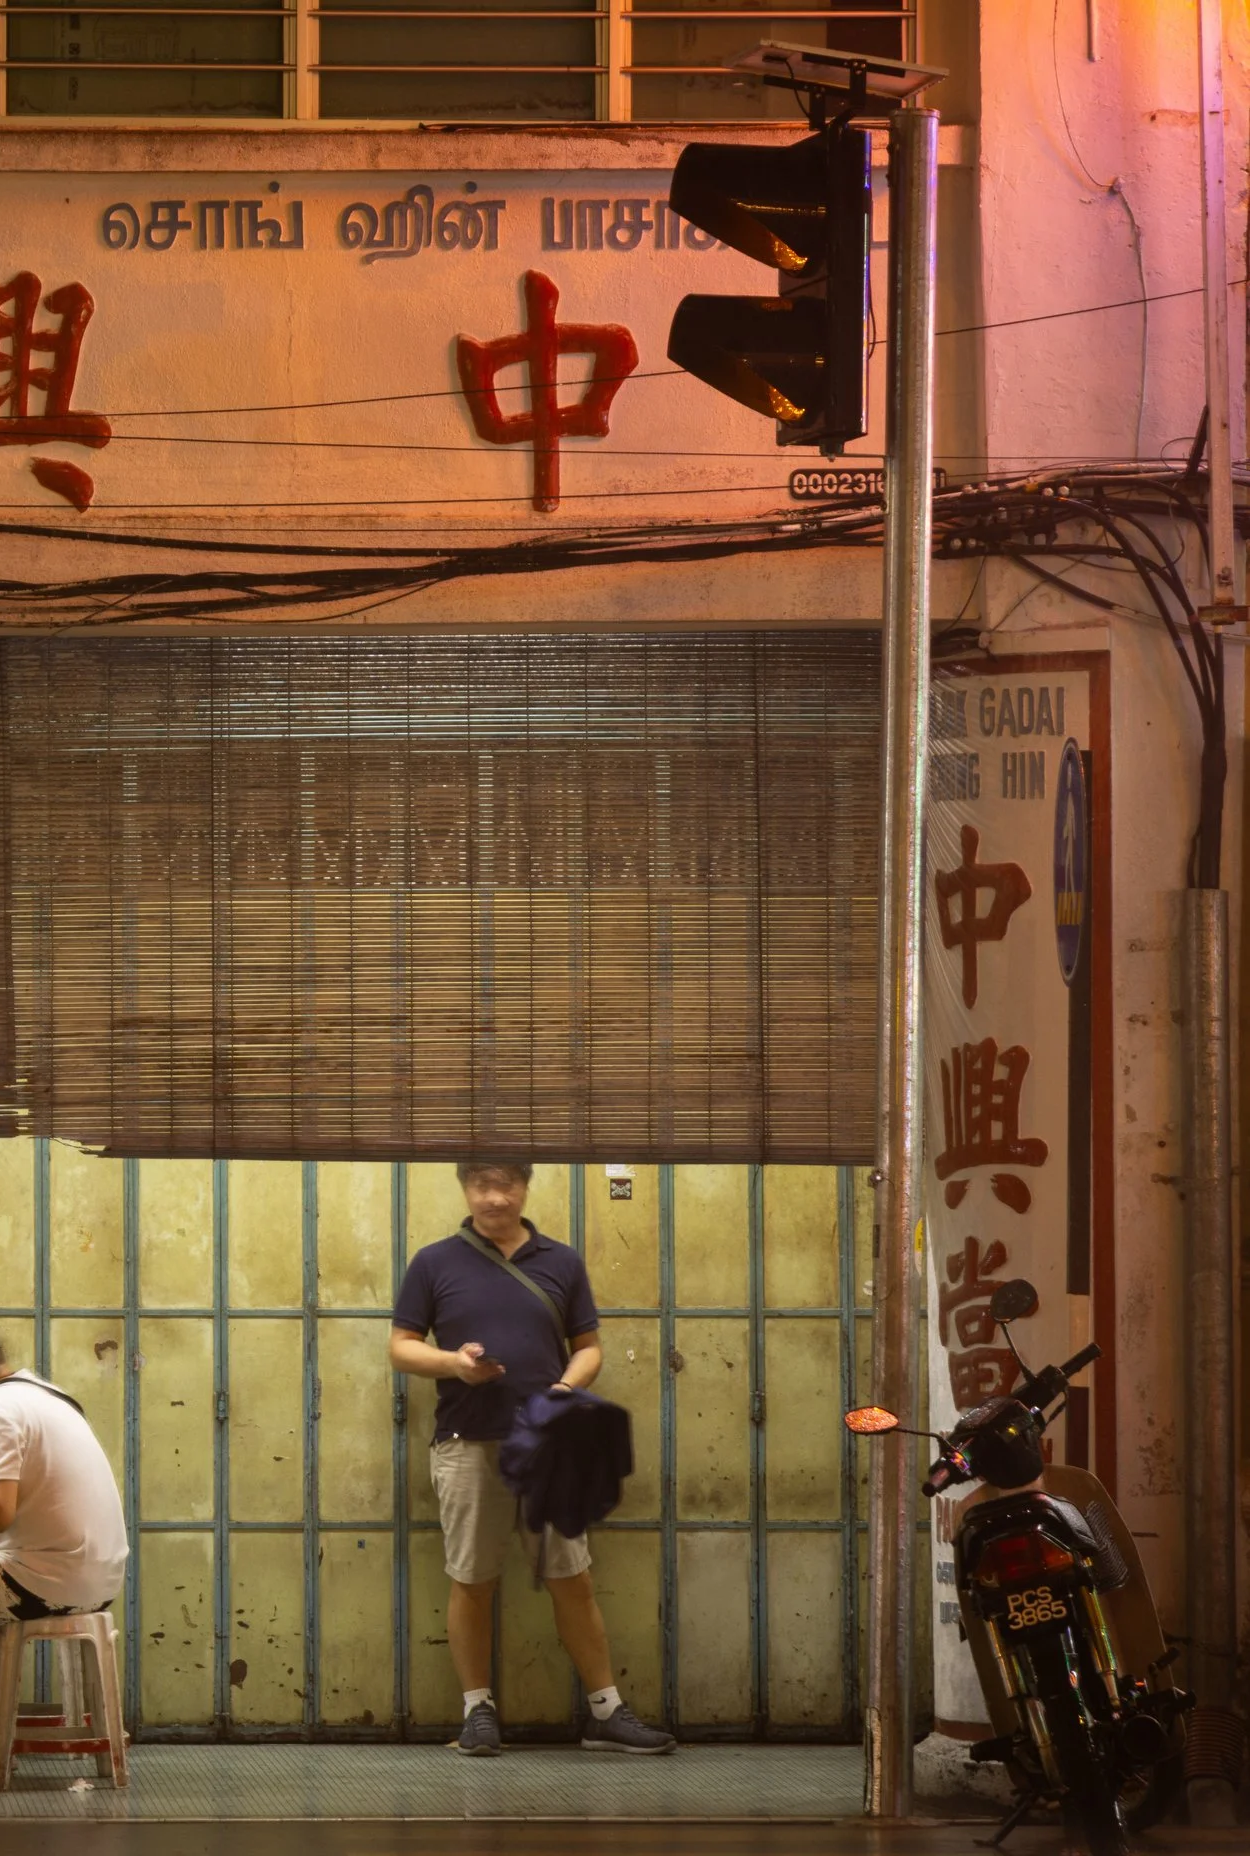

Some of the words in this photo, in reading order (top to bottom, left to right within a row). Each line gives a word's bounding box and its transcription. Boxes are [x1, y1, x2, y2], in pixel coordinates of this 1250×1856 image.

[979, 686, 1065, 738] GADAI
[1002, 751, 1046, 800] HIN
[1007, 1586, 1053, 1613] PCS
[1007, 1600, 1068, 1631] 3865
